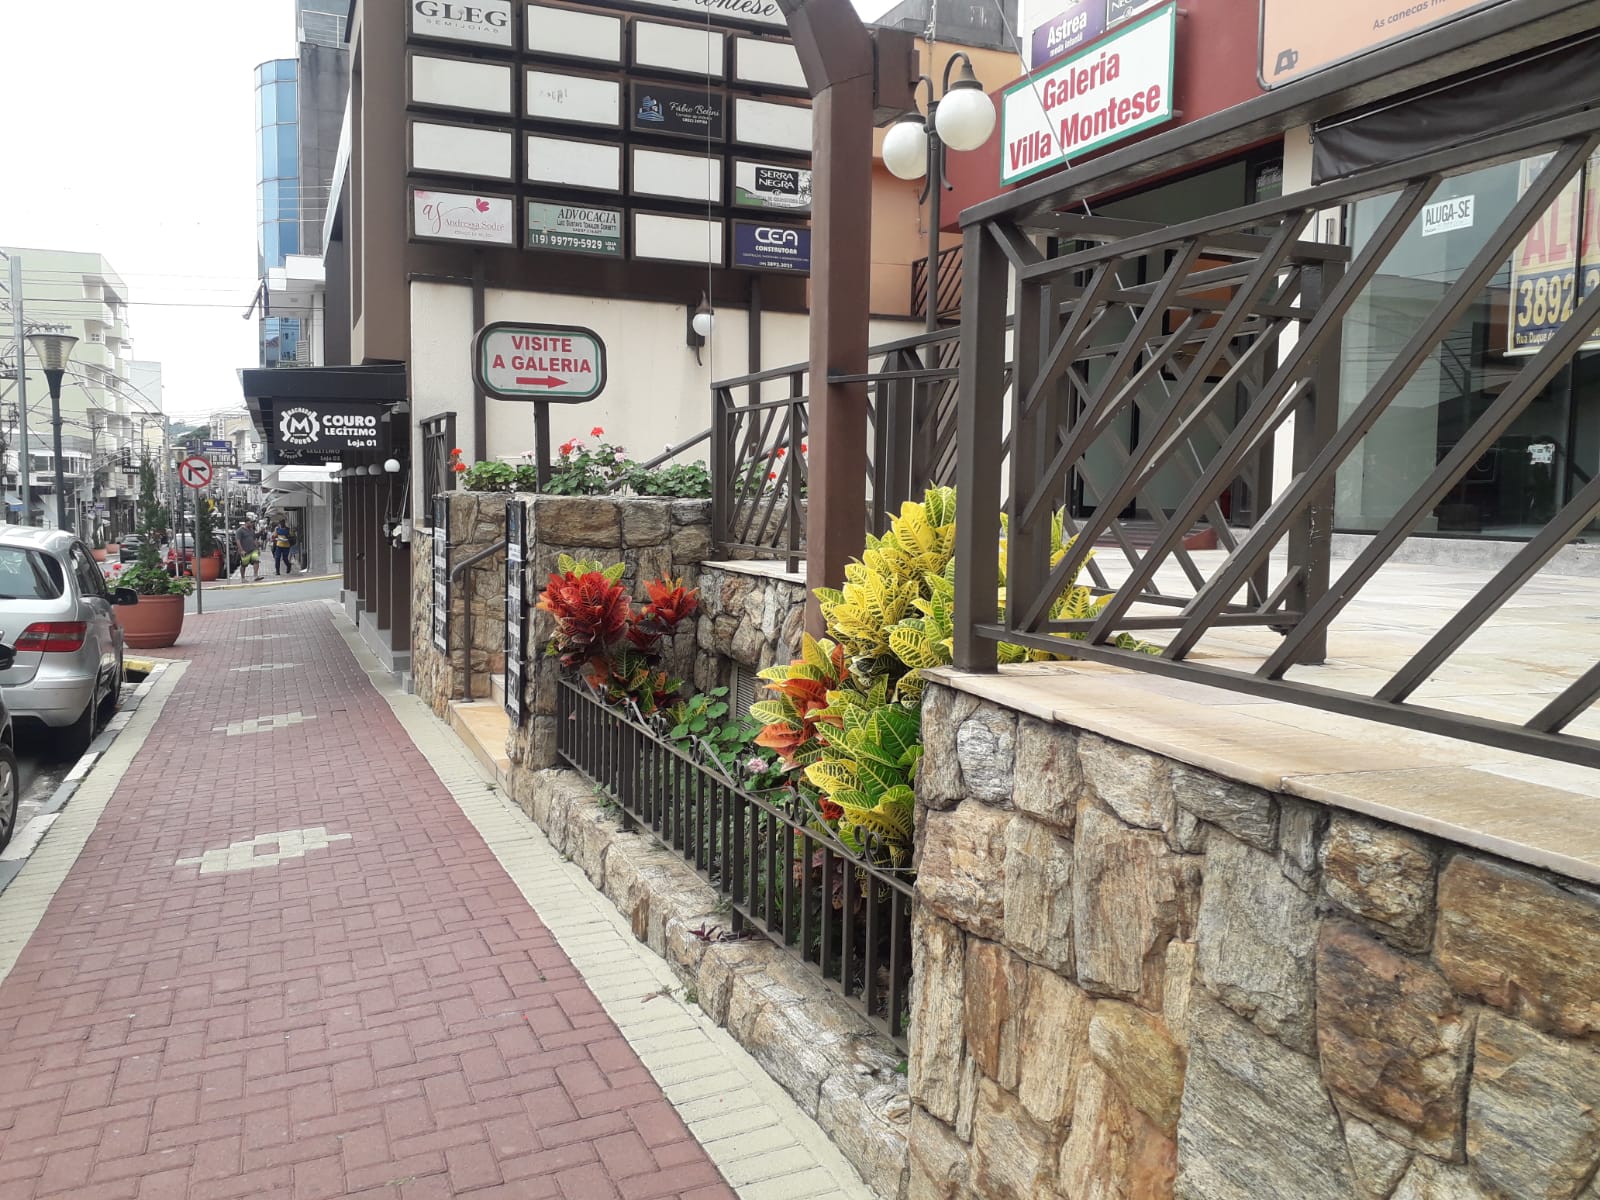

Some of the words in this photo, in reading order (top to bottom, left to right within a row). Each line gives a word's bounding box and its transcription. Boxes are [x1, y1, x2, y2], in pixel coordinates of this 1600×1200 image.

[415, 1, 507, 27] GLEG
[1373, 18, 1385, 31] As
[1387, 1, 1429, 24] canecas
[1047, 11, 1088, 49] Astrea
[1043, 51, 1120, 111] Galeria
[1009, 131, 1052, 171] Villa
[1059, 84, 1160, 150] Montese
[758, 178, 795, 189] NEGRA
[760, 169, 794, 180] SERRA
[557, 208, 617, 224] ADVOCACIA
[1425, 199, 1471, 226] ALUGA-SE
[531, 233, 549, 245] (19)
[550, 235, 602, 249] 99779-5929
[755, 227, 798, 247] CEA
[511, 335, 572, 353] VISITE
[492, 354, 505, 369] A
[511, 355, 592, 373] GALERIA
[290, 416, 310, 433] M
[322, 414, 377, 427] COURO
[347, 439, 365, 448] Loja
[366, 439, 377, 447] 01
